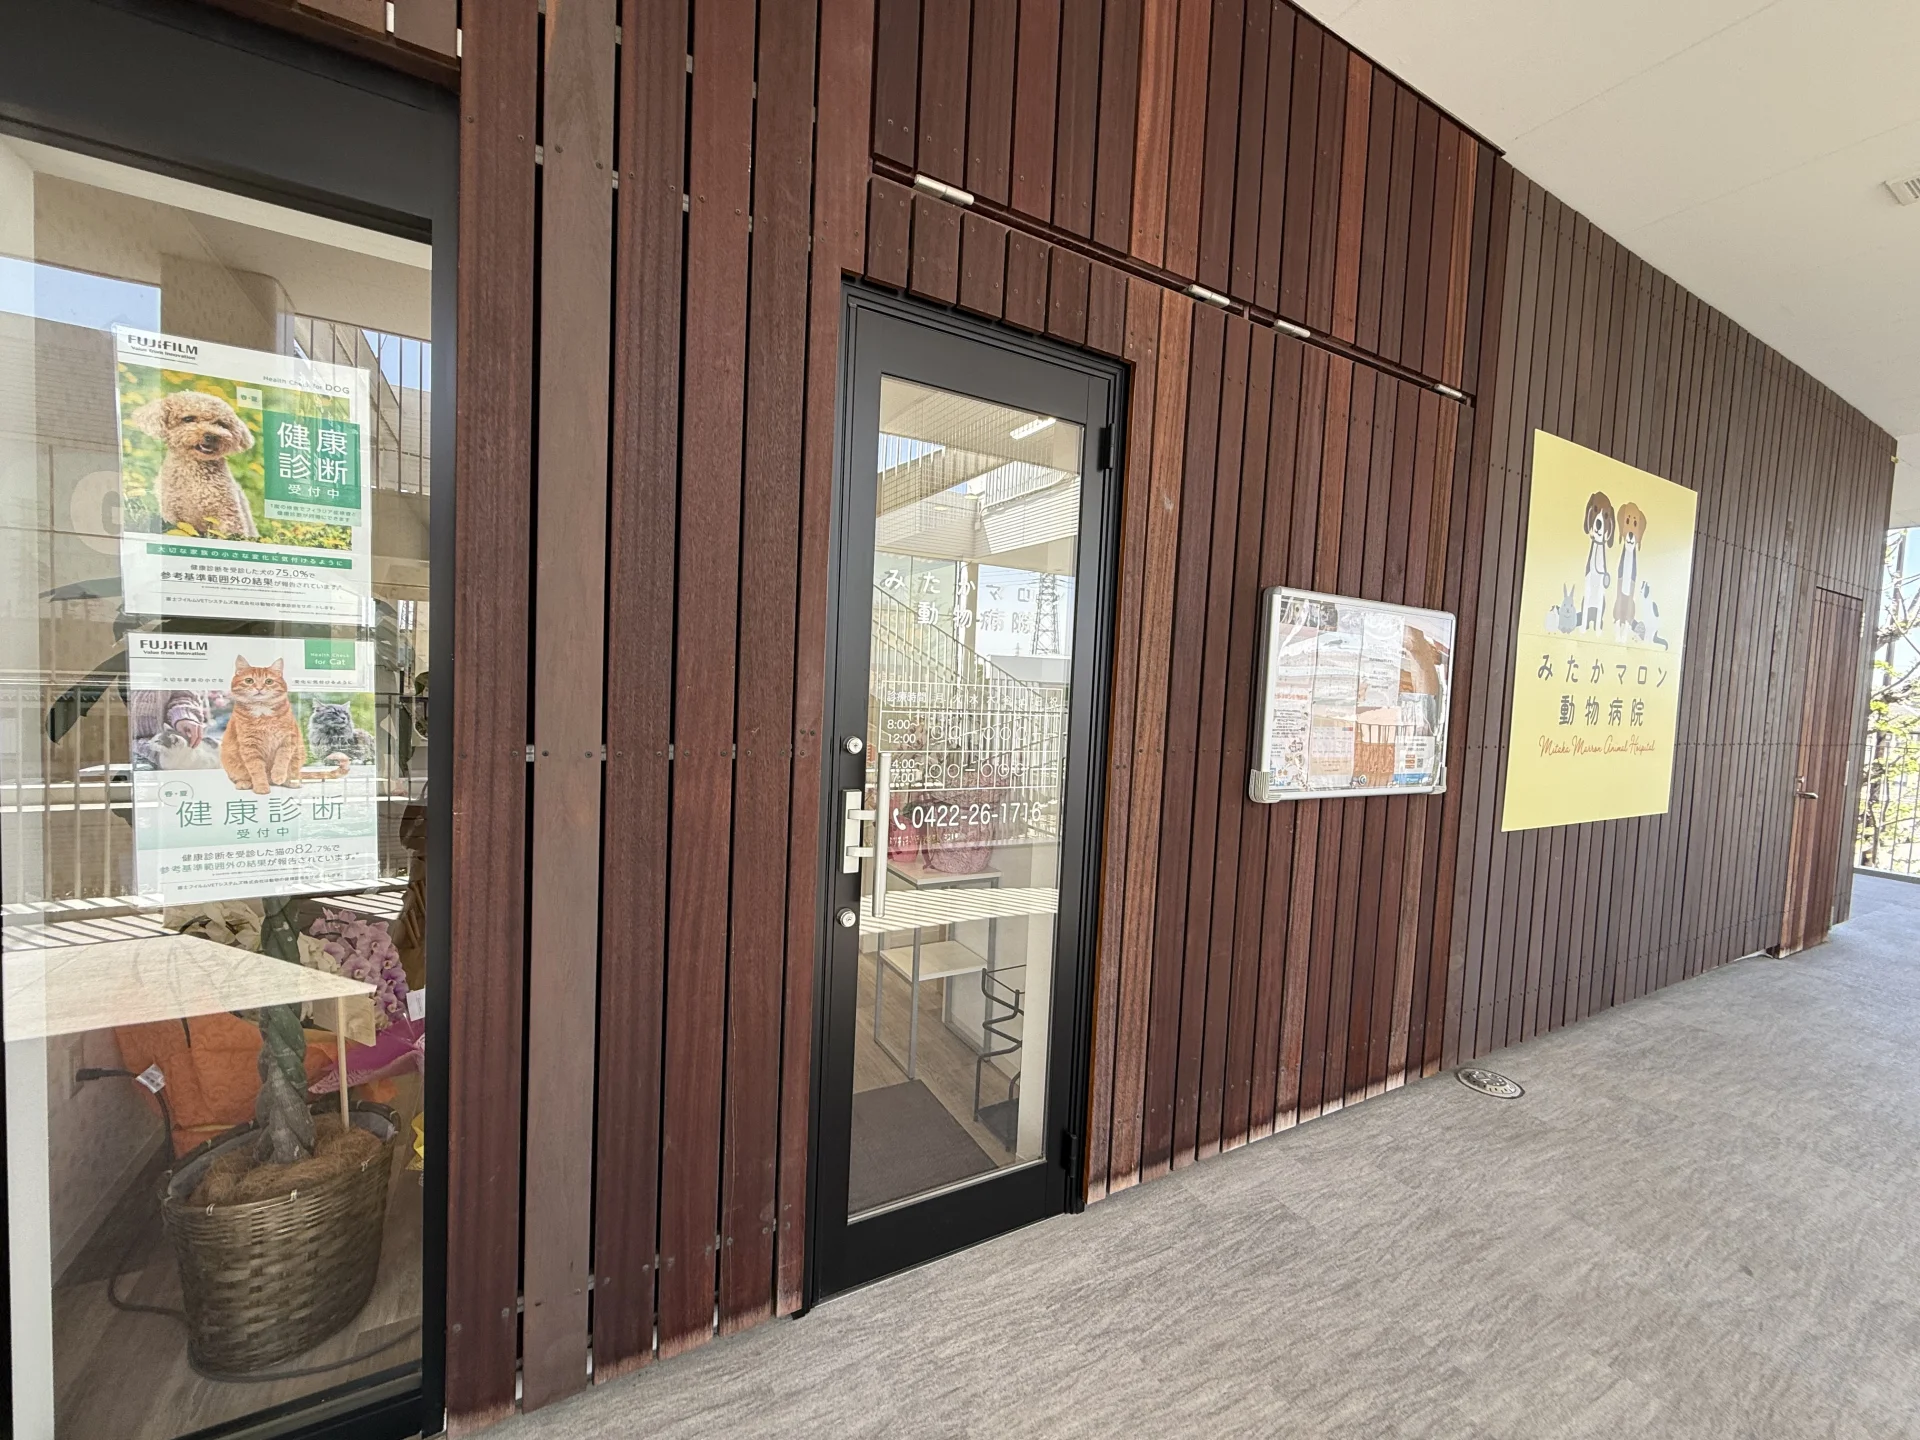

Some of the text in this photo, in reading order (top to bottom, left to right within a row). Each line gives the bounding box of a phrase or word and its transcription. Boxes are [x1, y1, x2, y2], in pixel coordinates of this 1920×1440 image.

[128, 334, 198, 355] FUJIFILM
[263, 375, 287, 384] Health
[325, 384, 350, 394] DOG
[277, 421, 348, 455] 健康
[279, 452, 348, 485] 診断
[288, 483, 340, 499] 受付中
[140, 639, 208, 651] FUJIFILM
[314, 658, 346, 666] for Cat
[1538, 654, 1667, 688] みたかマロン
[1559, 695, 1645, 726] 動物病院
[888, 733, 916, 744] 12:00
[1539, 735, 1570, 757] Mitaka
[1603, 735, 1628, 755] Animal
[891, 758, 924, 769] 4:00~
[891, 773, 914, 783] 7:00
[176, 795, 344, 828] 健康診断
[912, 802, 1042, 829] 0422-26-1716
[236, 827, 289, 839] 受付中
